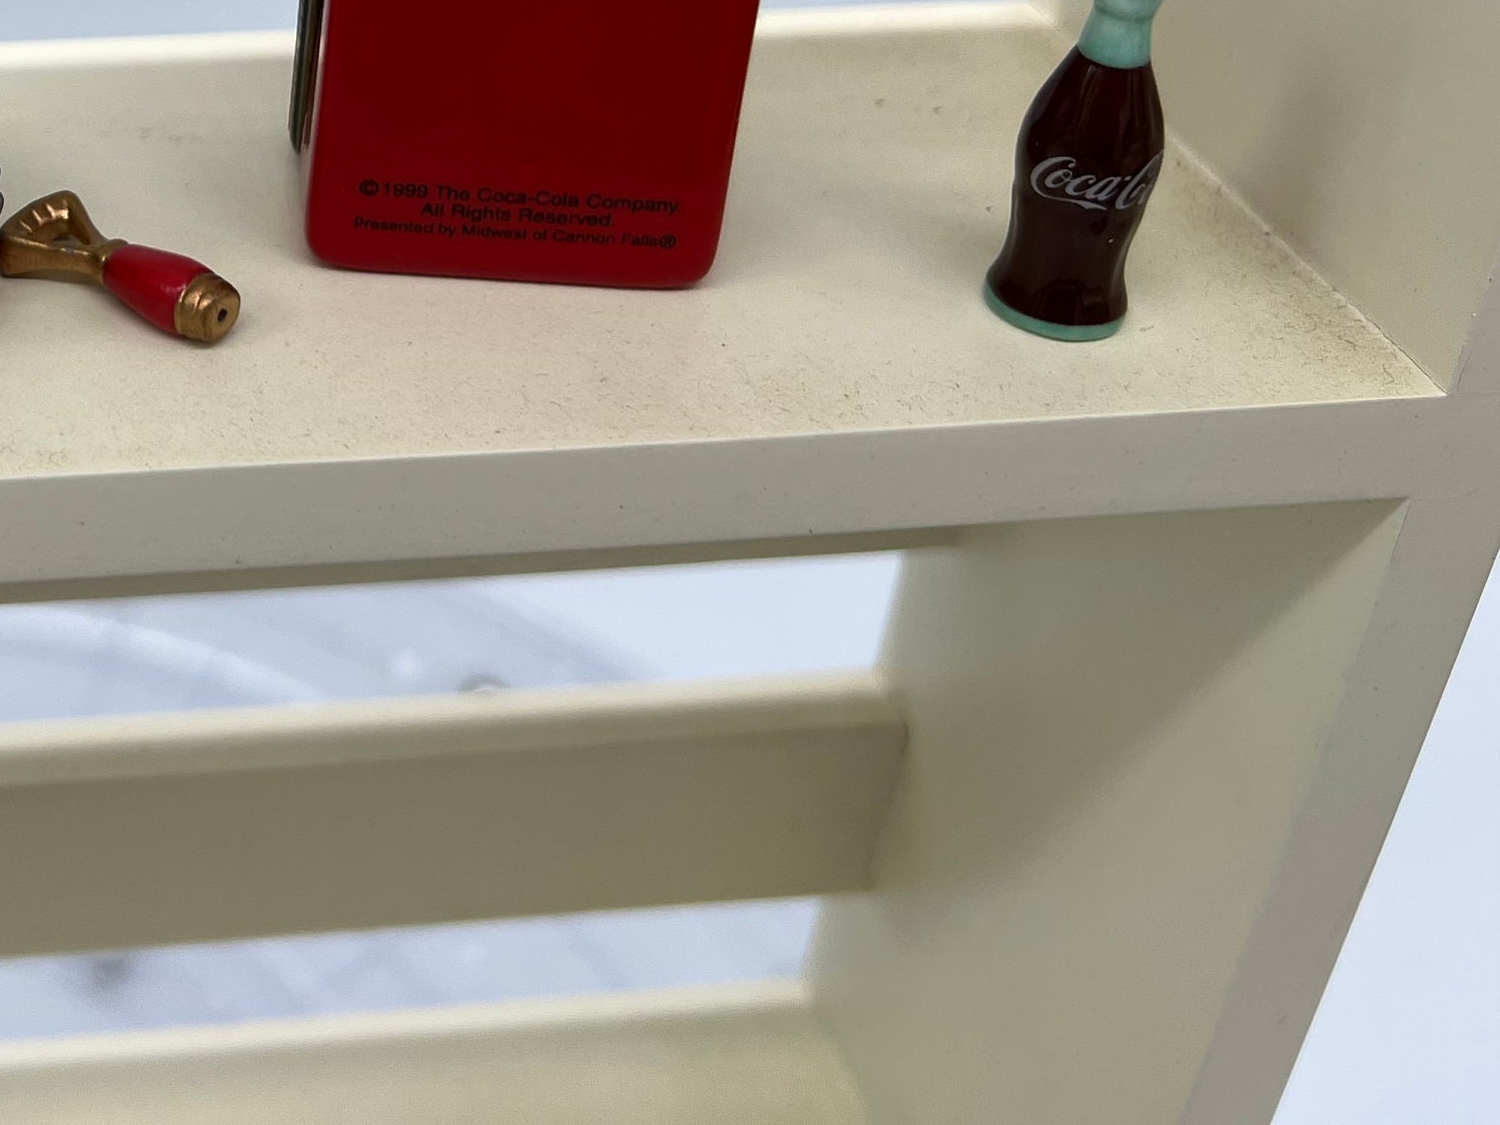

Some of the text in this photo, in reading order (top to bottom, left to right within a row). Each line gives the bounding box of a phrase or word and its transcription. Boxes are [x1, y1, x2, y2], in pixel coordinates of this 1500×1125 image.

[436, 185, 470, 201] The
[478, 187, 579, 208] Coca-Cola
[421, 203, 445, 217] All
[452, 204, 511, 223] Rights
[354, 216, 434, 235] Presented
[438, 223, 456, 237] by
[462, 226, 527, 241] Midwest
[532, 229, 548, 242] of
[553, 229, 615, 246] Cannon
